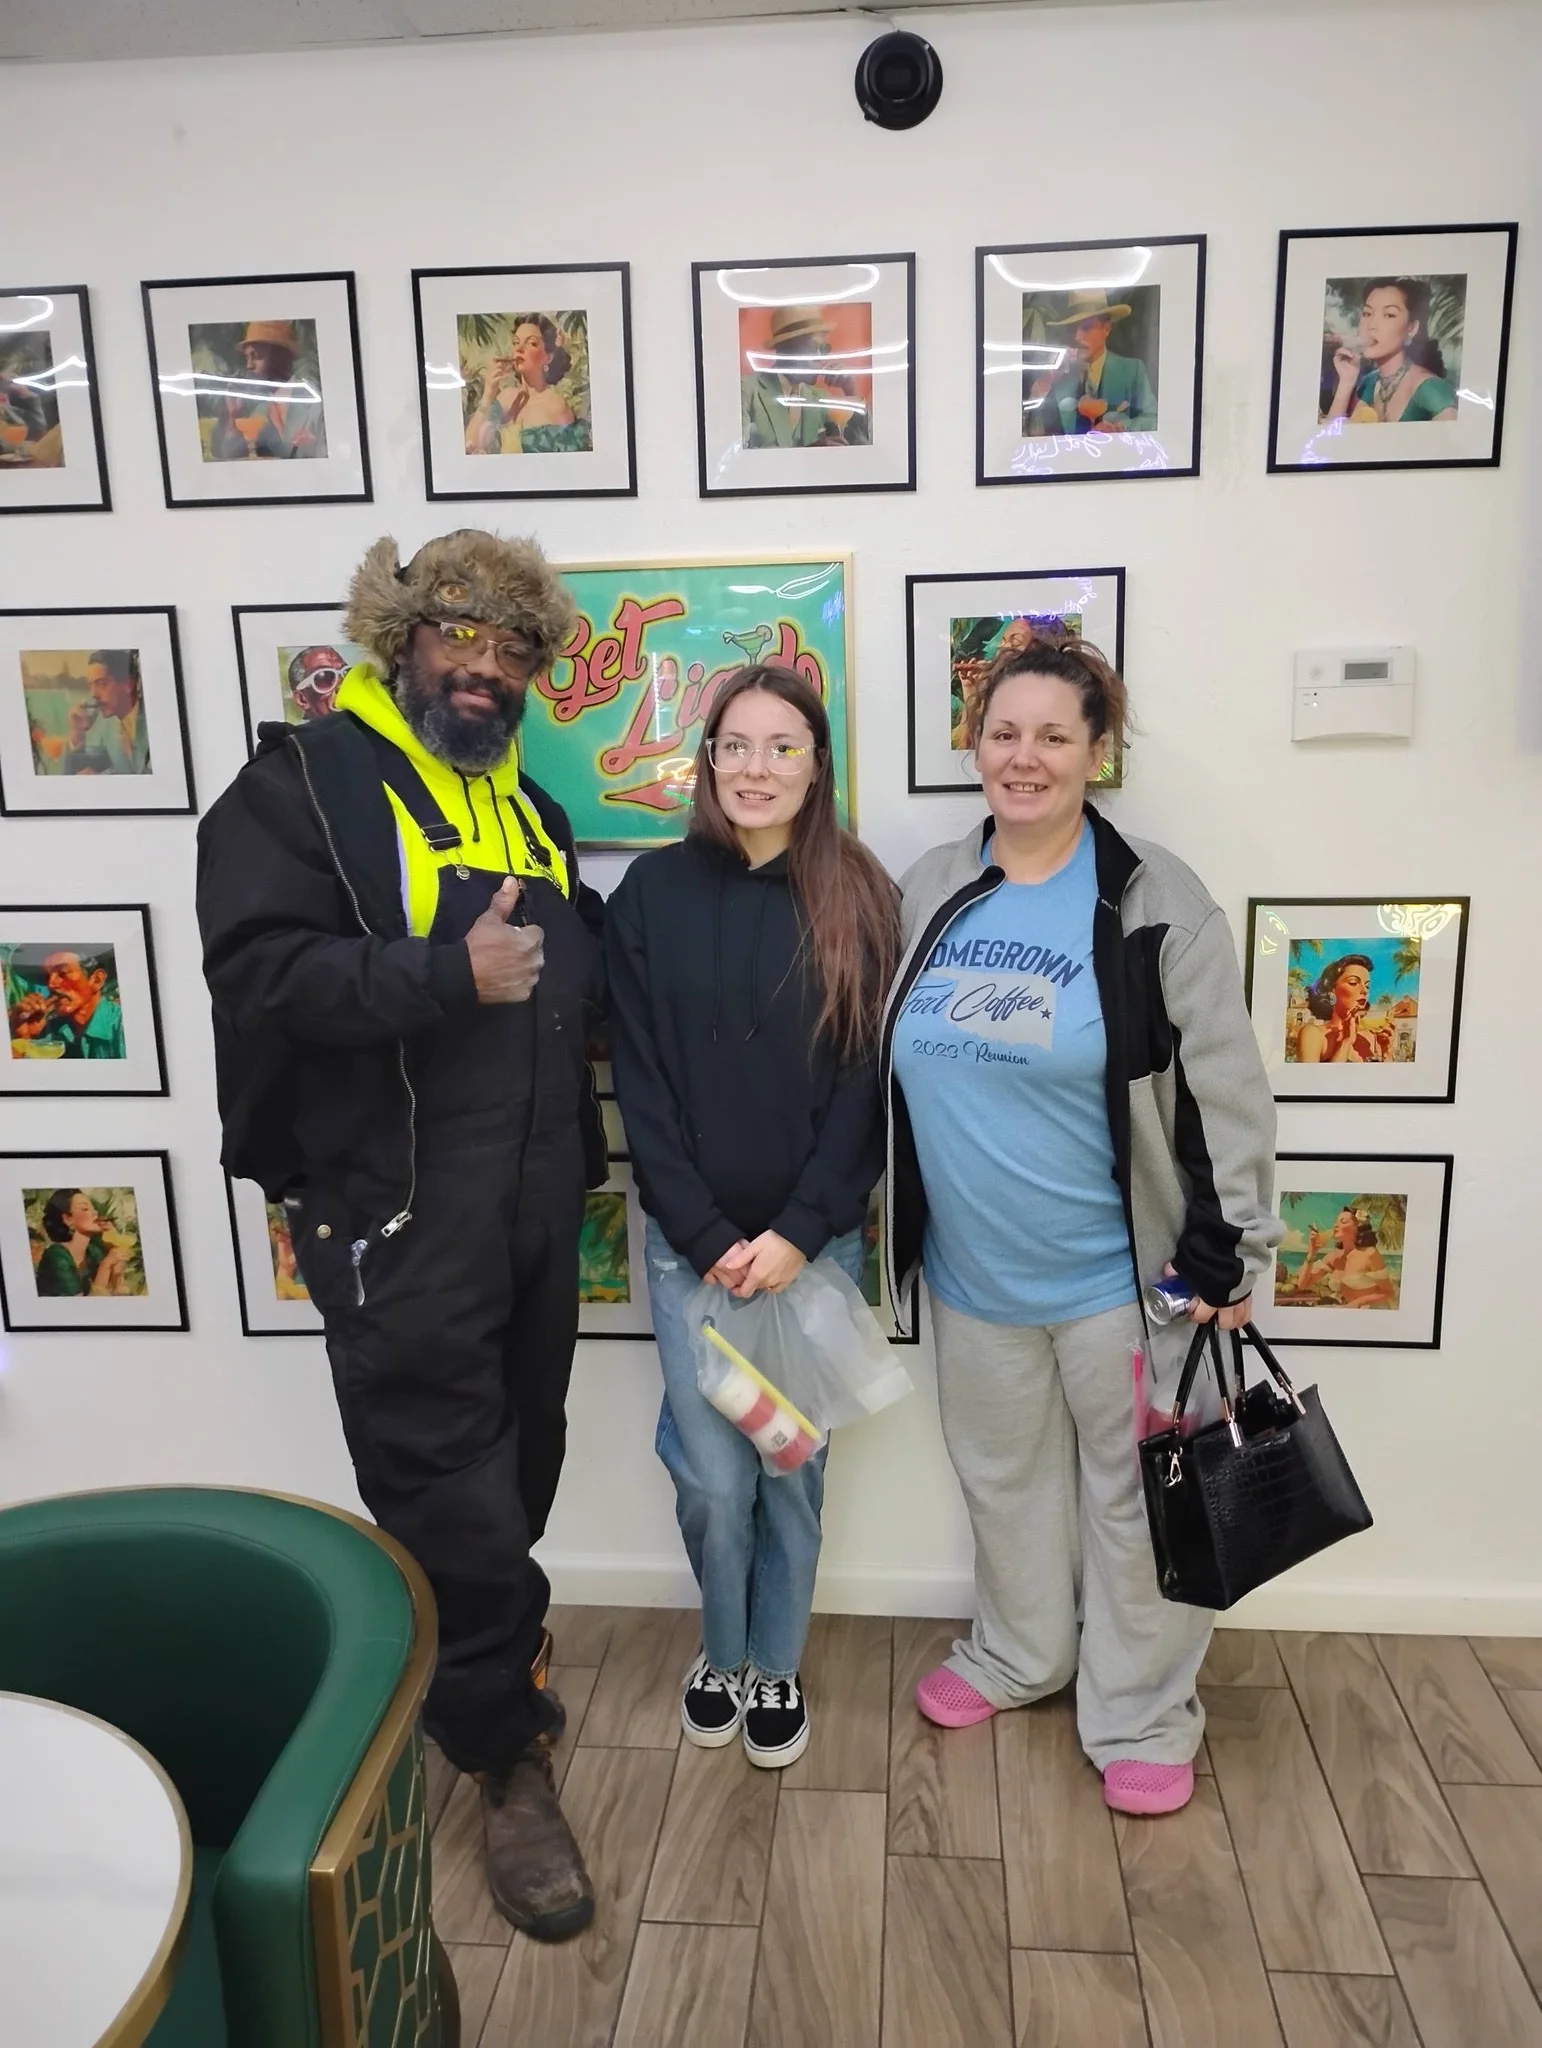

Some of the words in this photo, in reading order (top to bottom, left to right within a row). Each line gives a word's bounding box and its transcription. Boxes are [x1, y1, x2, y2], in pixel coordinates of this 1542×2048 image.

[536, 598, 685, 722] Get
[923, 939, 1084, 988] OMEGROWN
[899, 981, 955, 1022] Fort
[950, 983, 1045, 1021] Coffee
[912, 1039, 959, 1059] 2023
[963, 1041, 1029, 1065] Reunion
